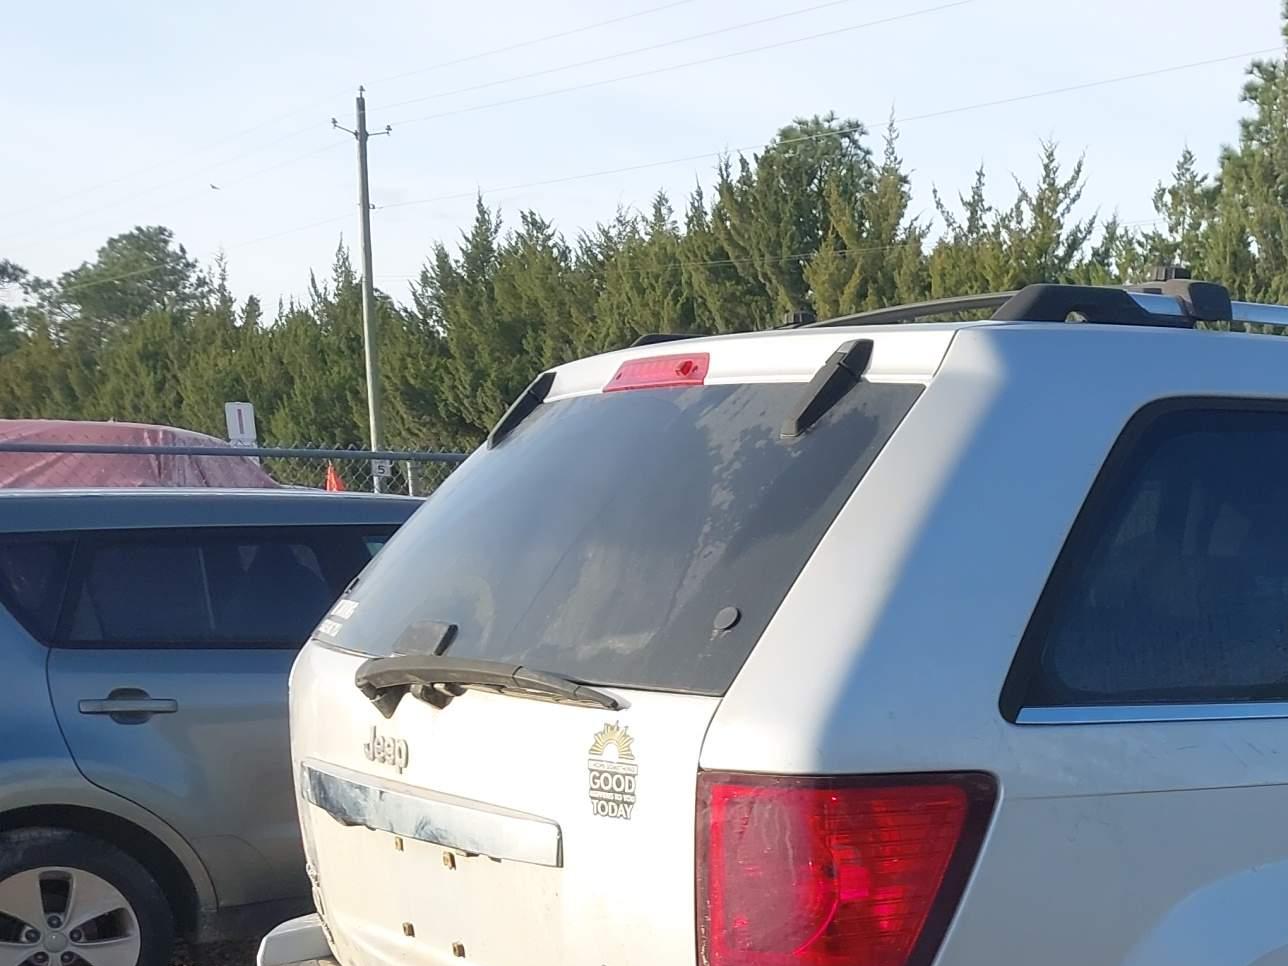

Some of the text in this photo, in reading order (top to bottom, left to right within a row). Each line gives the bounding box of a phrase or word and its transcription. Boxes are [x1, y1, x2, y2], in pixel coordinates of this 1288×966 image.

[363, 725, 409, 775] Jeep
[590, 771, 635, 793] GOOD
[591, 799, 634, 820] TODAY
